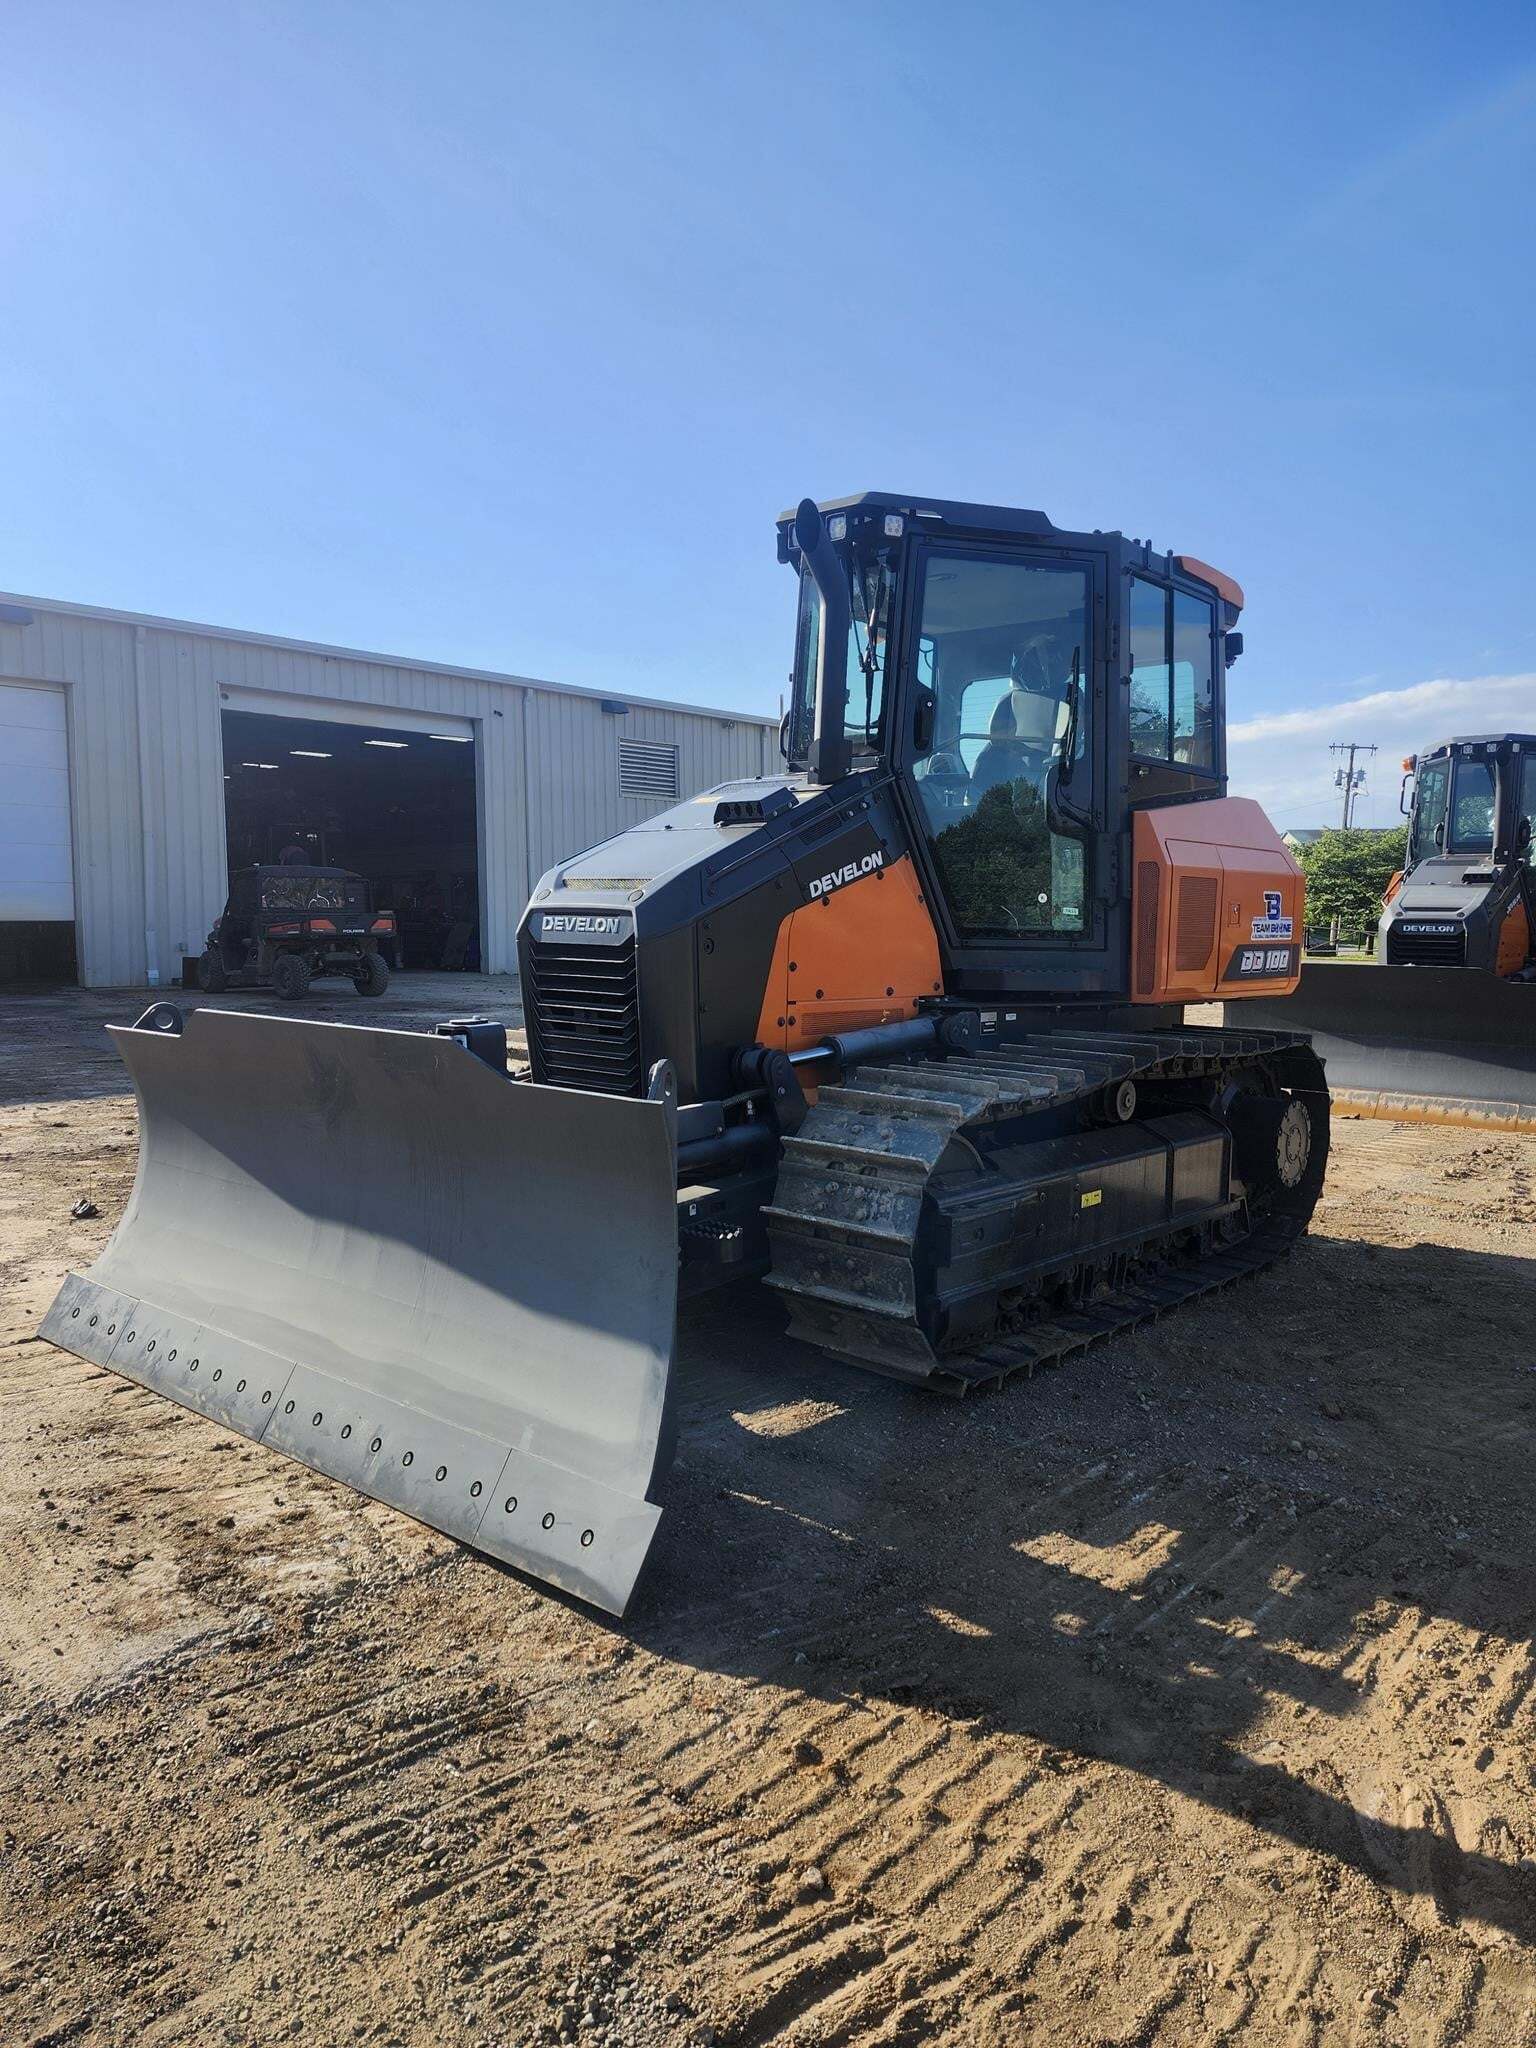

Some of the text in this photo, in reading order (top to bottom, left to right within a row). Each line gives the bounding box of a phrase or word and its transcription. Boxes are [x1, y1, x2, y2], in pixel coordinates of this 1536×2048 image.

[809, 850, 883, 898] DEVELON
[542, 916, 619, 933] DEVELON
[1253, 923, 1270, 933] TEAM
[1403, 924, 1455, 933] DEVELON
